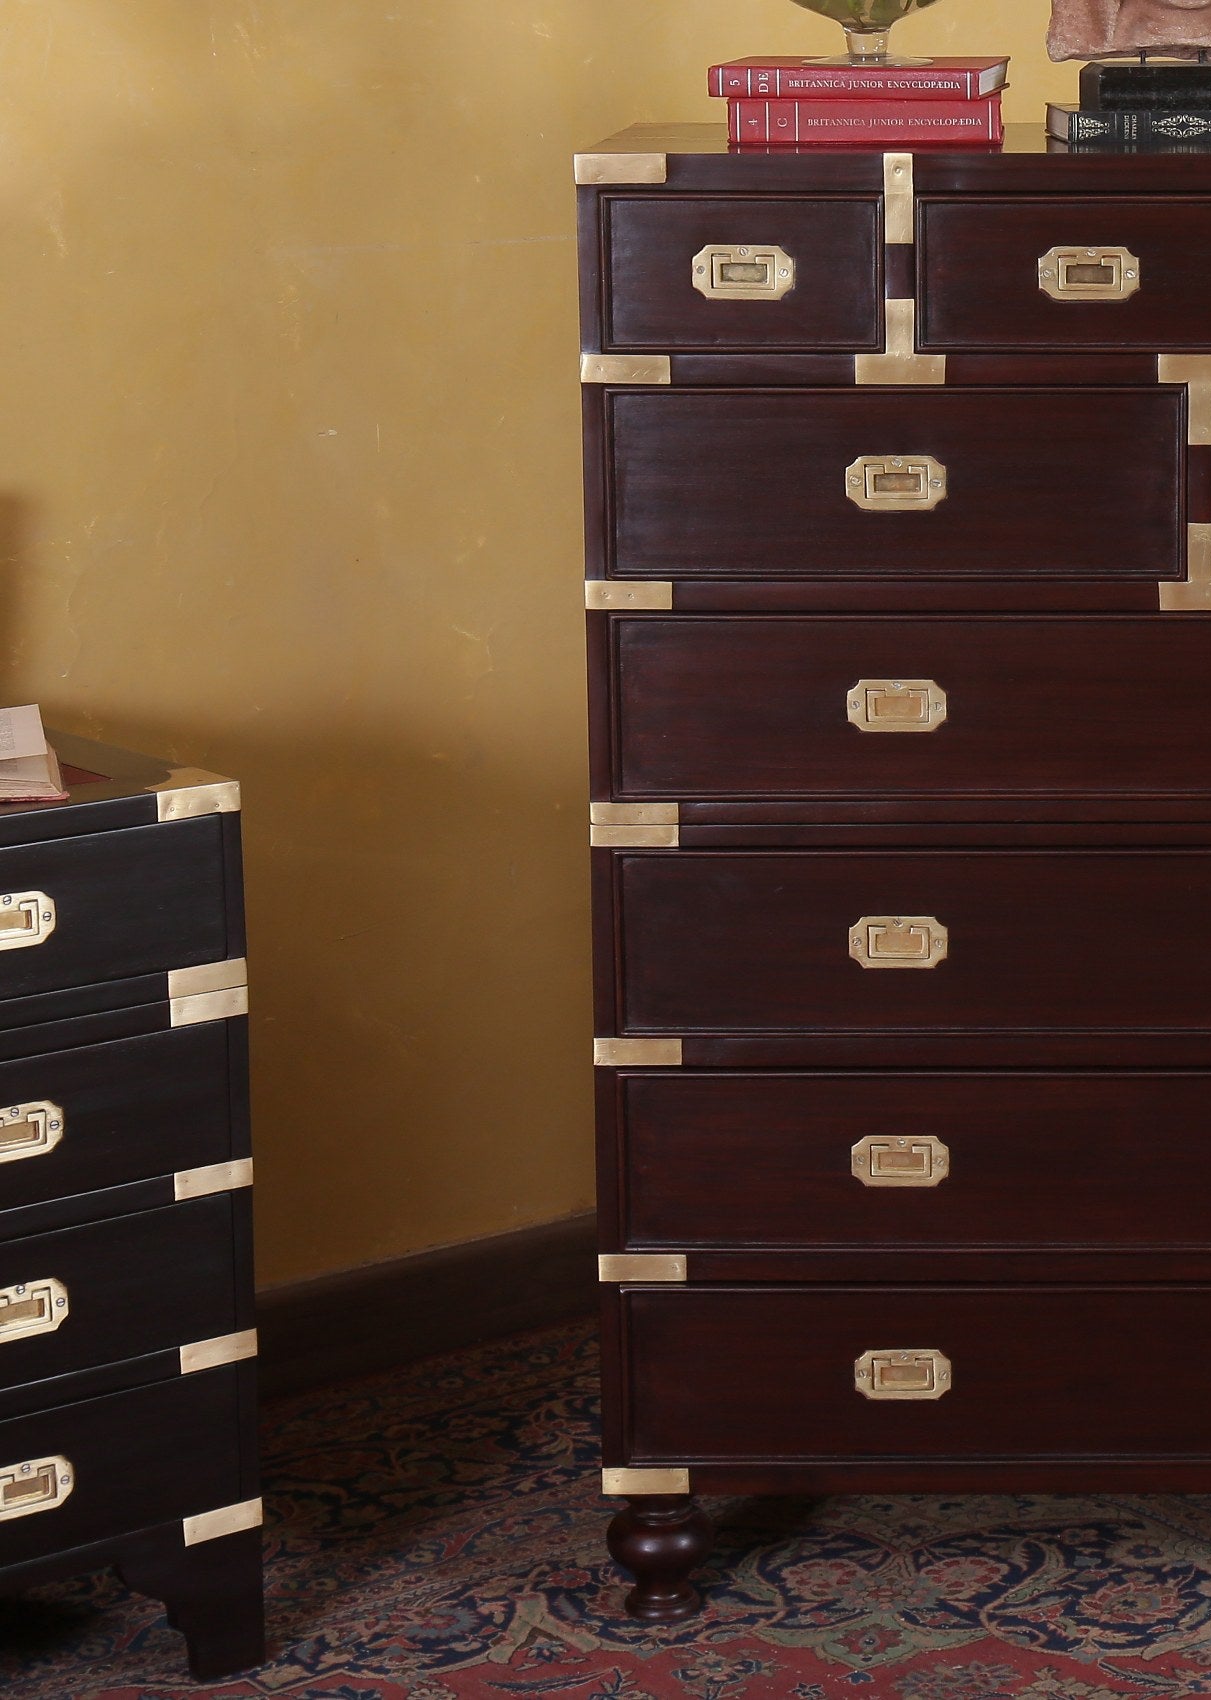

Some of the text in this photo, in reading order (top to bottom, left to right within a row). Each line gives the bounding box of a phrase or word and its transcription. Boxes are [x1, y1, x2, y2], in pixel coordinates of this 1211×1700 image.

[788, 80, 961, 90] BRITANNICA JUNIOR ENCYCLOPÆDIA
[777, 117, 788, 127] C
[868, 119, 904, 128] JUNIOR
[908, 118, 983, 126] ENCYCLOPÆDIA
